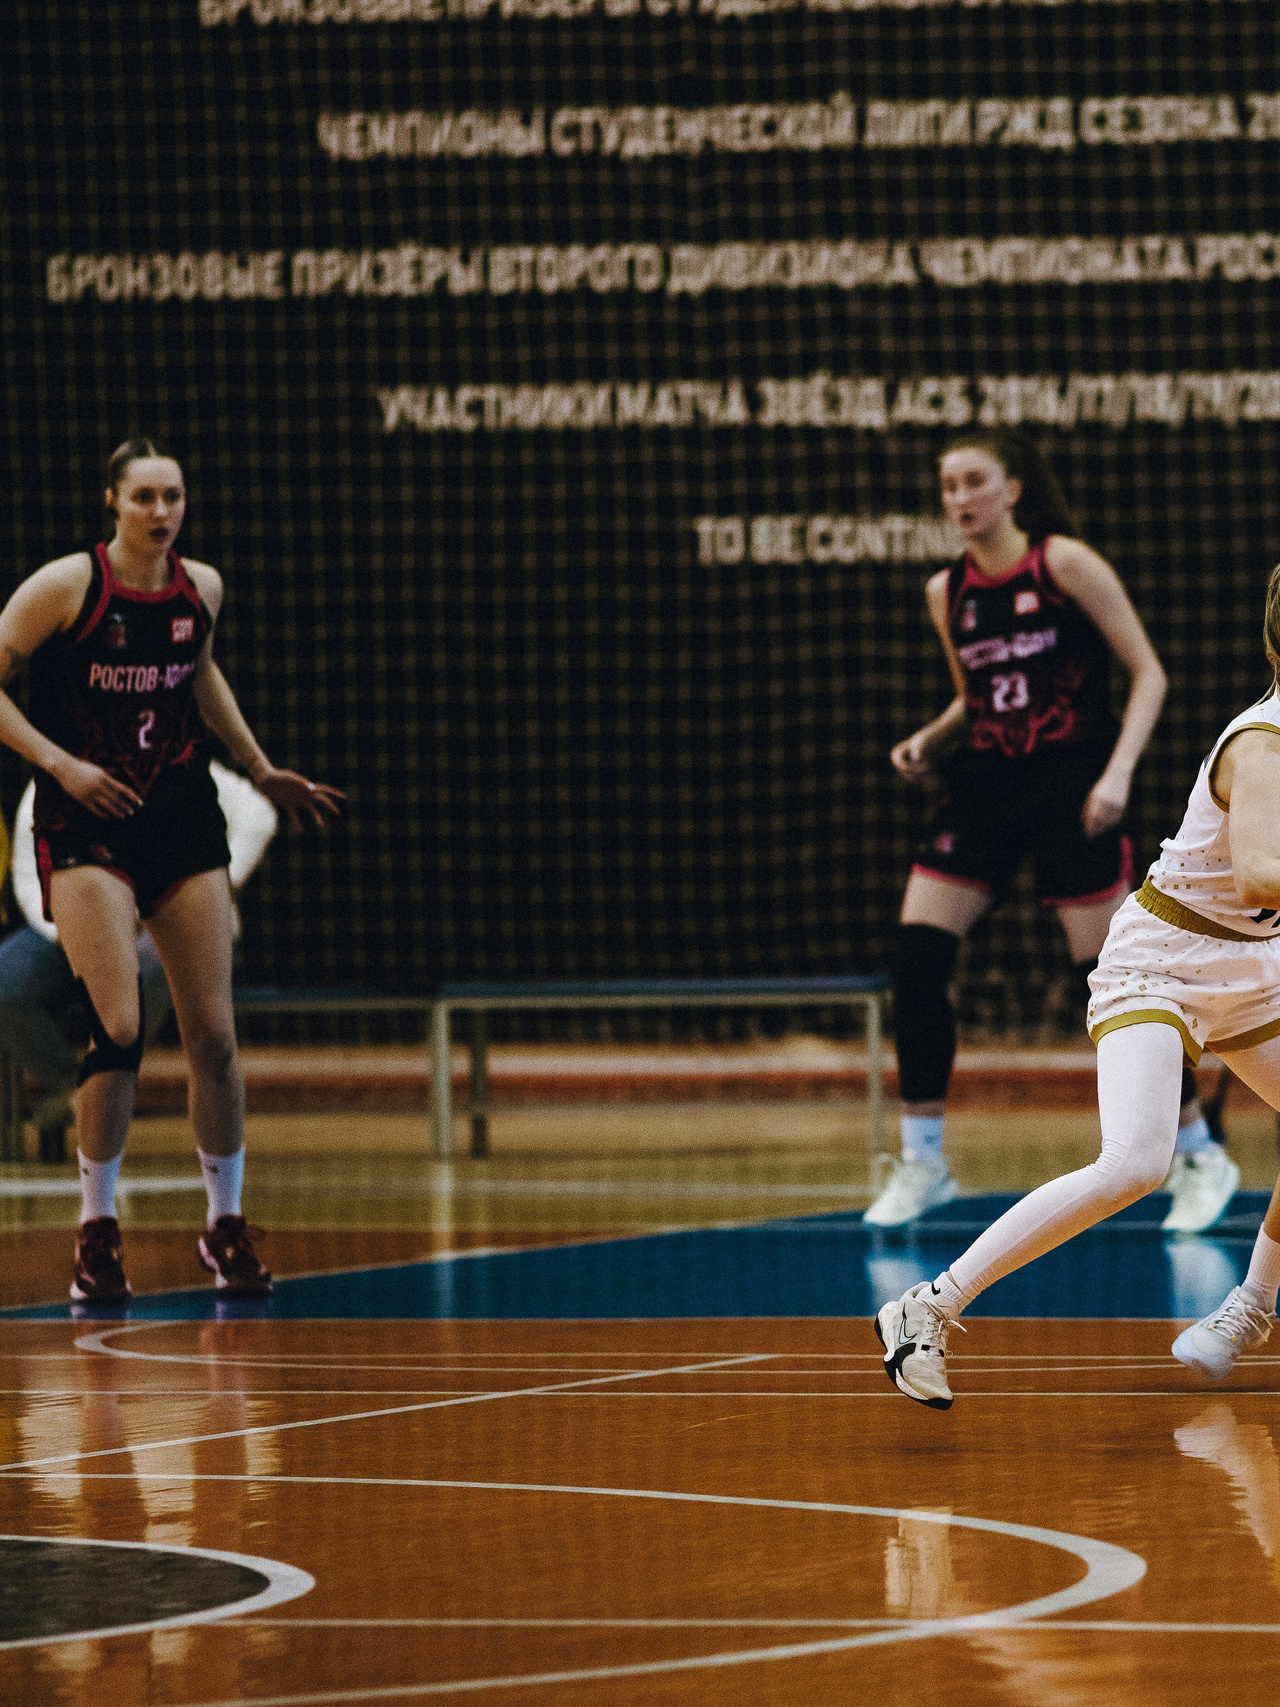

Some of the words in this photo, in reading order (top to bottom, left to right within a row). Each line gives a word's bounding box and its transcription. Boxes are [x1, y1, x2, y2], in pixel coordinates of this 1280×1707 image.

[317, 110, 546, 161] ЧЕМПИОНЫ
[550, 90, 857, 161] СТУДЕНЧЕСКОЙ
[1080, 95, 1240, 147] СЕЗОНА
[46, 250, 288, 301] БРОНЗОВЫЕ
[290, 240, 486, 298] ПРИЗЁРЫ
[488, 242, 664, 296] ВТОРОГО
[665, 239, 920, 296] ДИВИЗИОНА
[915, 233, 1197, 290] ЧЕМПИОНАТА
[377, 381, 609, 433] УЧАСТНИКИ
[614, 378, 751, 428] МАТЧА
[695, 514, 745, 565] TO
[749, 513, 803, 565] BE
[803, 513, 967, 564] CONTIN
[990, 670, 1029, 713] 23
[137, 709, 156, 750] 2
